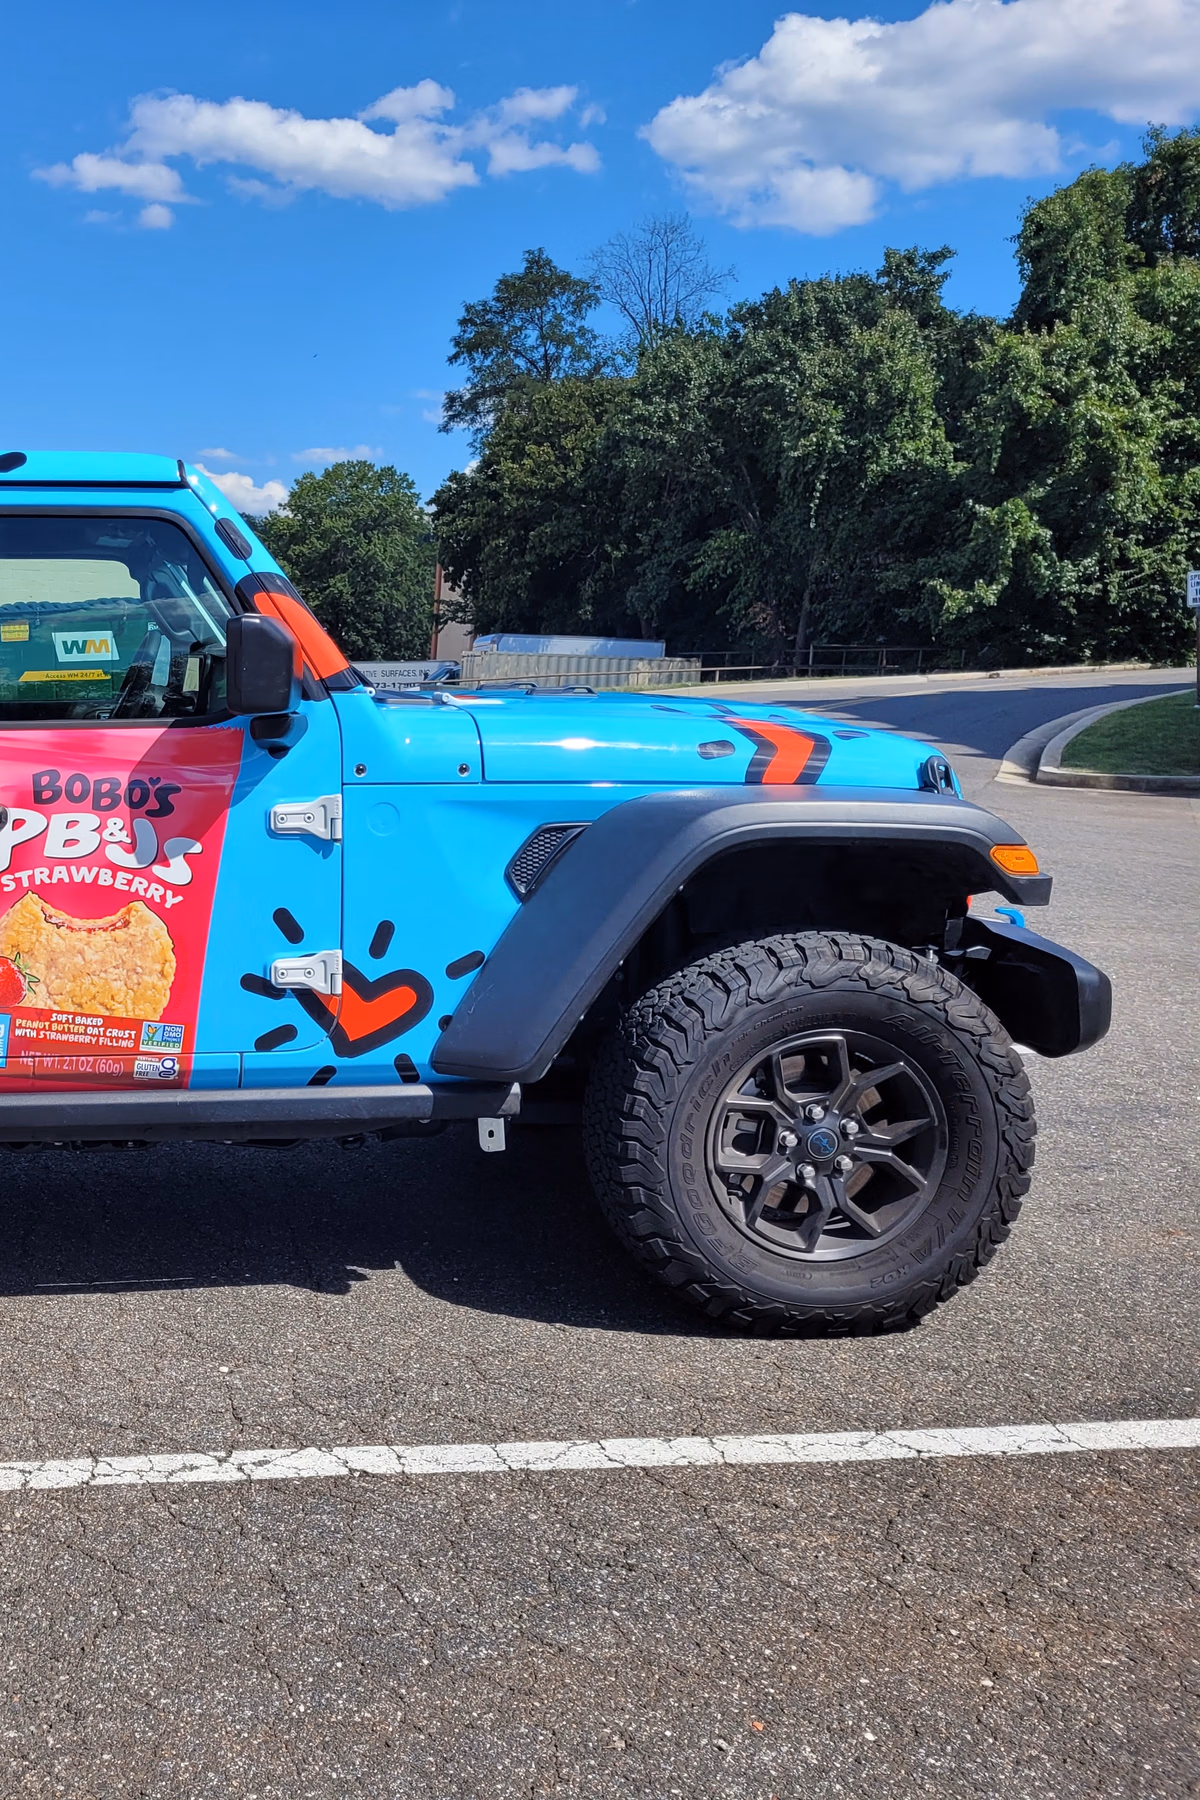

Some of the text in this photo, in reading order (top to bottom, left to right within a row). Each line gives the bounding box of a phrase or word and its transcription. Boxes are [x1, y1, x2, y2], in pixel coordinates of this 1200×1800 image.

[62, 638, 110, 655] WM
[32, 768, 181, 818] BOBO'S
[1, 865, 184, 909] STRAWBERRY
[15, 1018, 136, 1039] PEANUT BUTTER OAT CRUST
[50, 1013, 103, 1026] SOFT BAKED
[15, 1028, 135, 1048] WITH STRAWBERRY FILLING
[143, 1040, 180, 1048] VERIFIED
[20, 1050, 41, 1067] NET
[63, 1057, 76, 1070] 2.1
[78, 1057, 93, 1072] OZ
[95, 1058, 124, 1077] (60g)
[136, 1062, 160, 1071] GLUTEN
[680, 1052, 760, 1275] BFGoodrich
